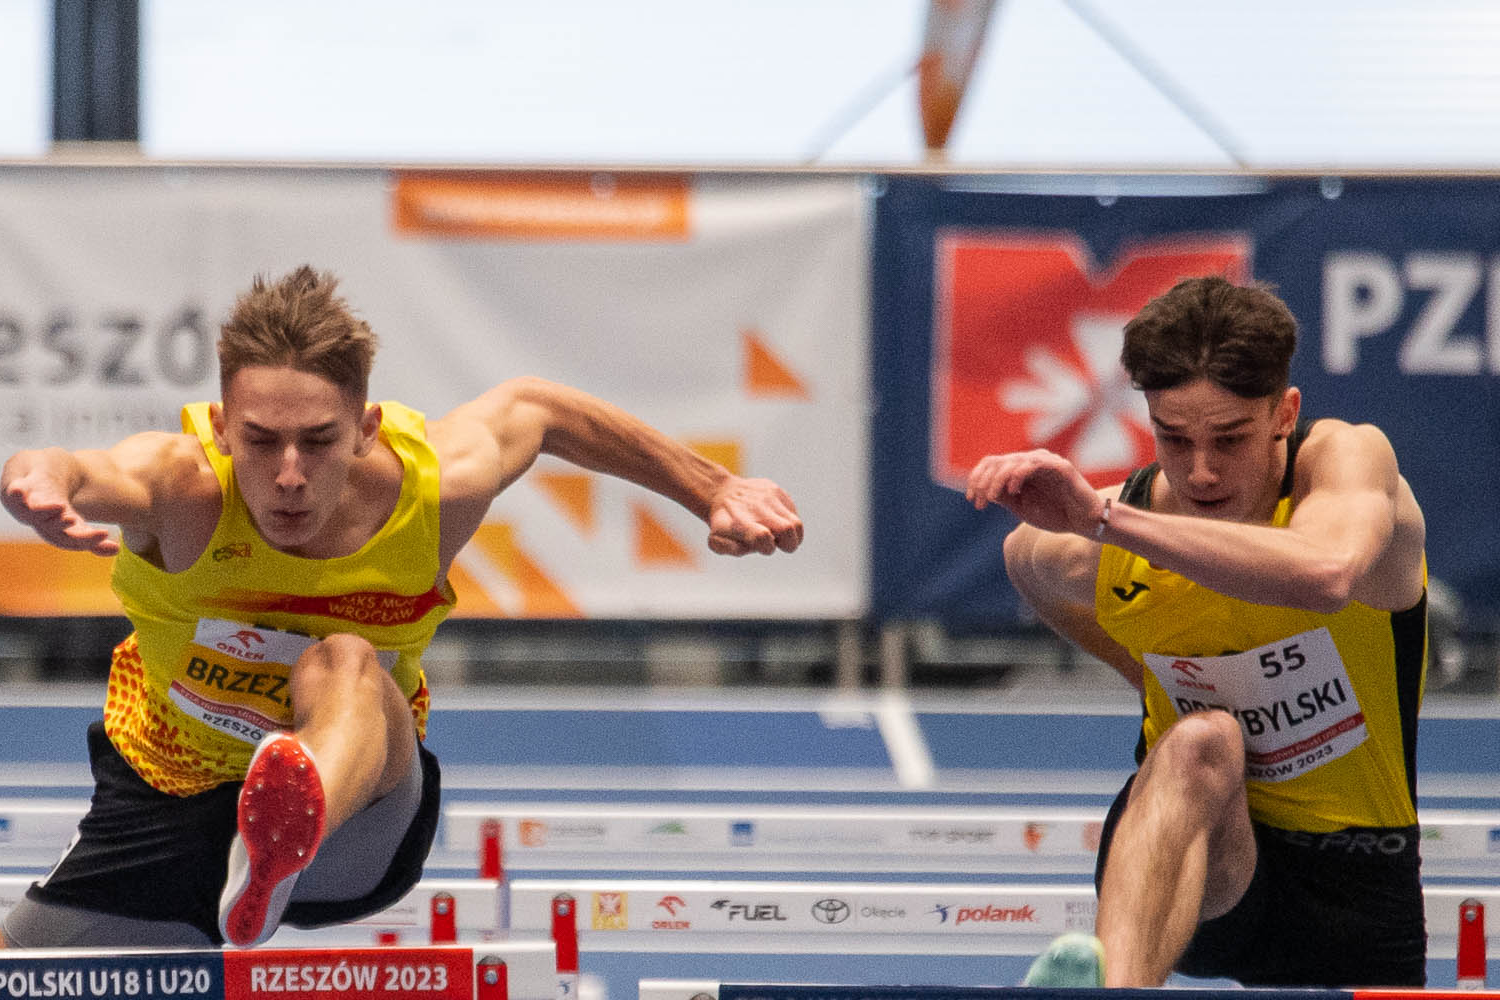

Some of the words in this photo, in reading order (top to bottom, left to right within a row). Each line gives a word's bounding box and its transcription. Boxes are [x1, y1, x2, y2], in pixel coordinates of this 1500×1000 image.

[1322, 250, 1500, 375] PZ
[216, 642, 265, 661] ORLEN
[1258, 643, 1306, 679] 55
[185, 656, 292, 708] BRZEZ
[202, 712, 262, 741] RZESZÓ
[1297, 745, 1334, 769] 2023
[728, 904, 788, 921] FUEL
[955, 903, 1037, 926] polanik
[89, 969, 139, 997] U18
[146, 969, 153, 996] i
[159, 968, 211, 995] U20
[250, 960, 379, 993] RZESZÓW
[385, 965, 449, 992] 2023
